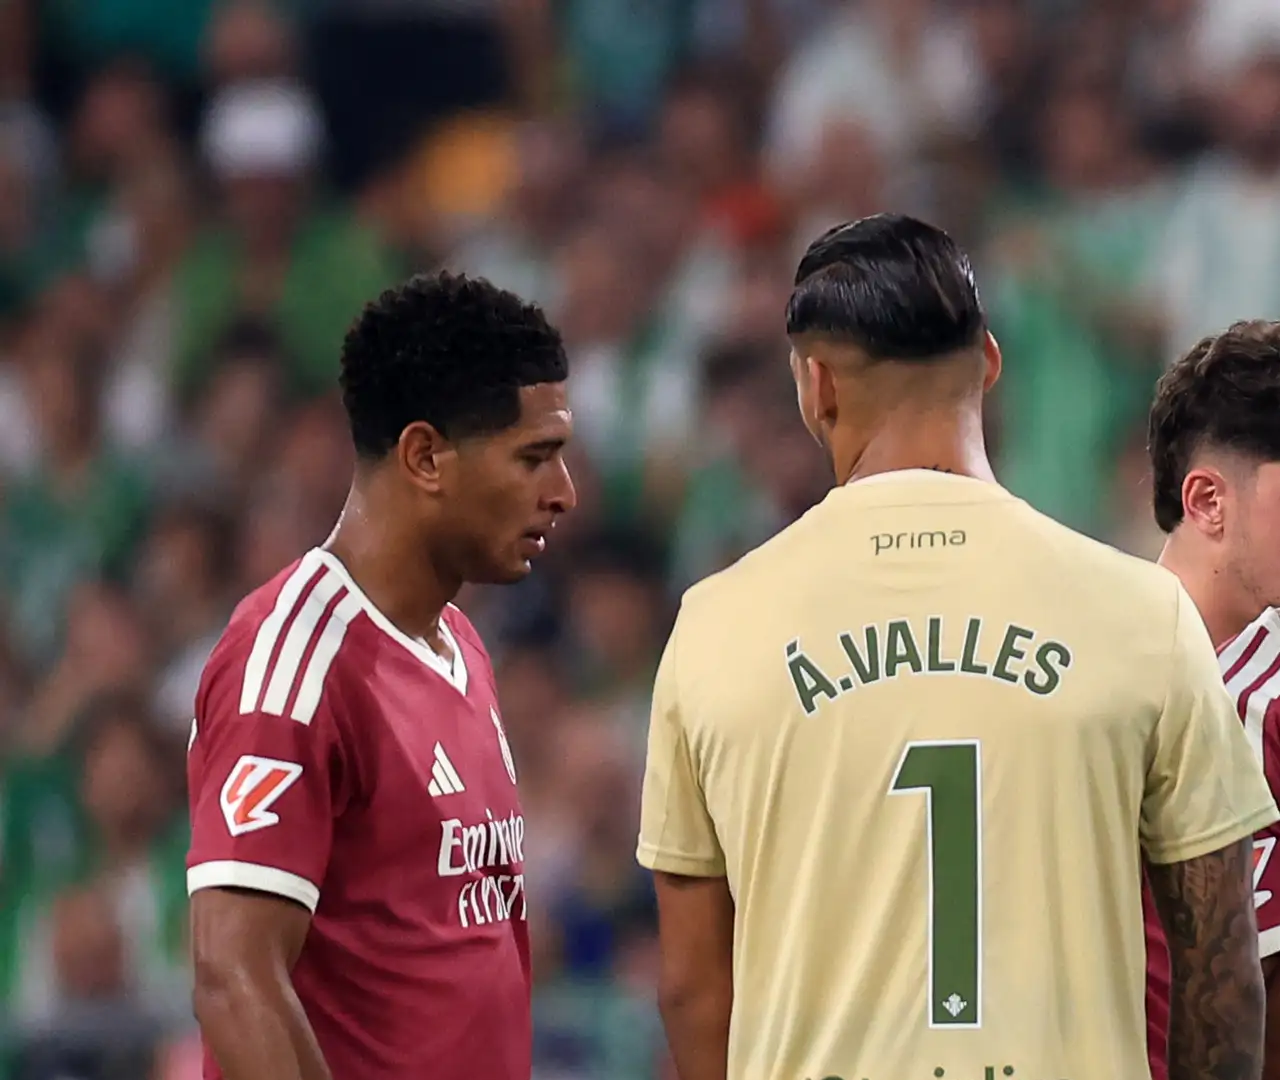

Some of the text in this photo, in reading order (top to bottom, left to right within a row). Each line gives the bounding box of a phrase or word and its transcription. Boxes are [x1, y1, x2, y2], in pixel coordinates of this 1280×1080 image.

[870, 529, 967, 556] prima
[785, 615, 1072, 716] Á.VALLES
[888, 738, 982, 1030] 1
